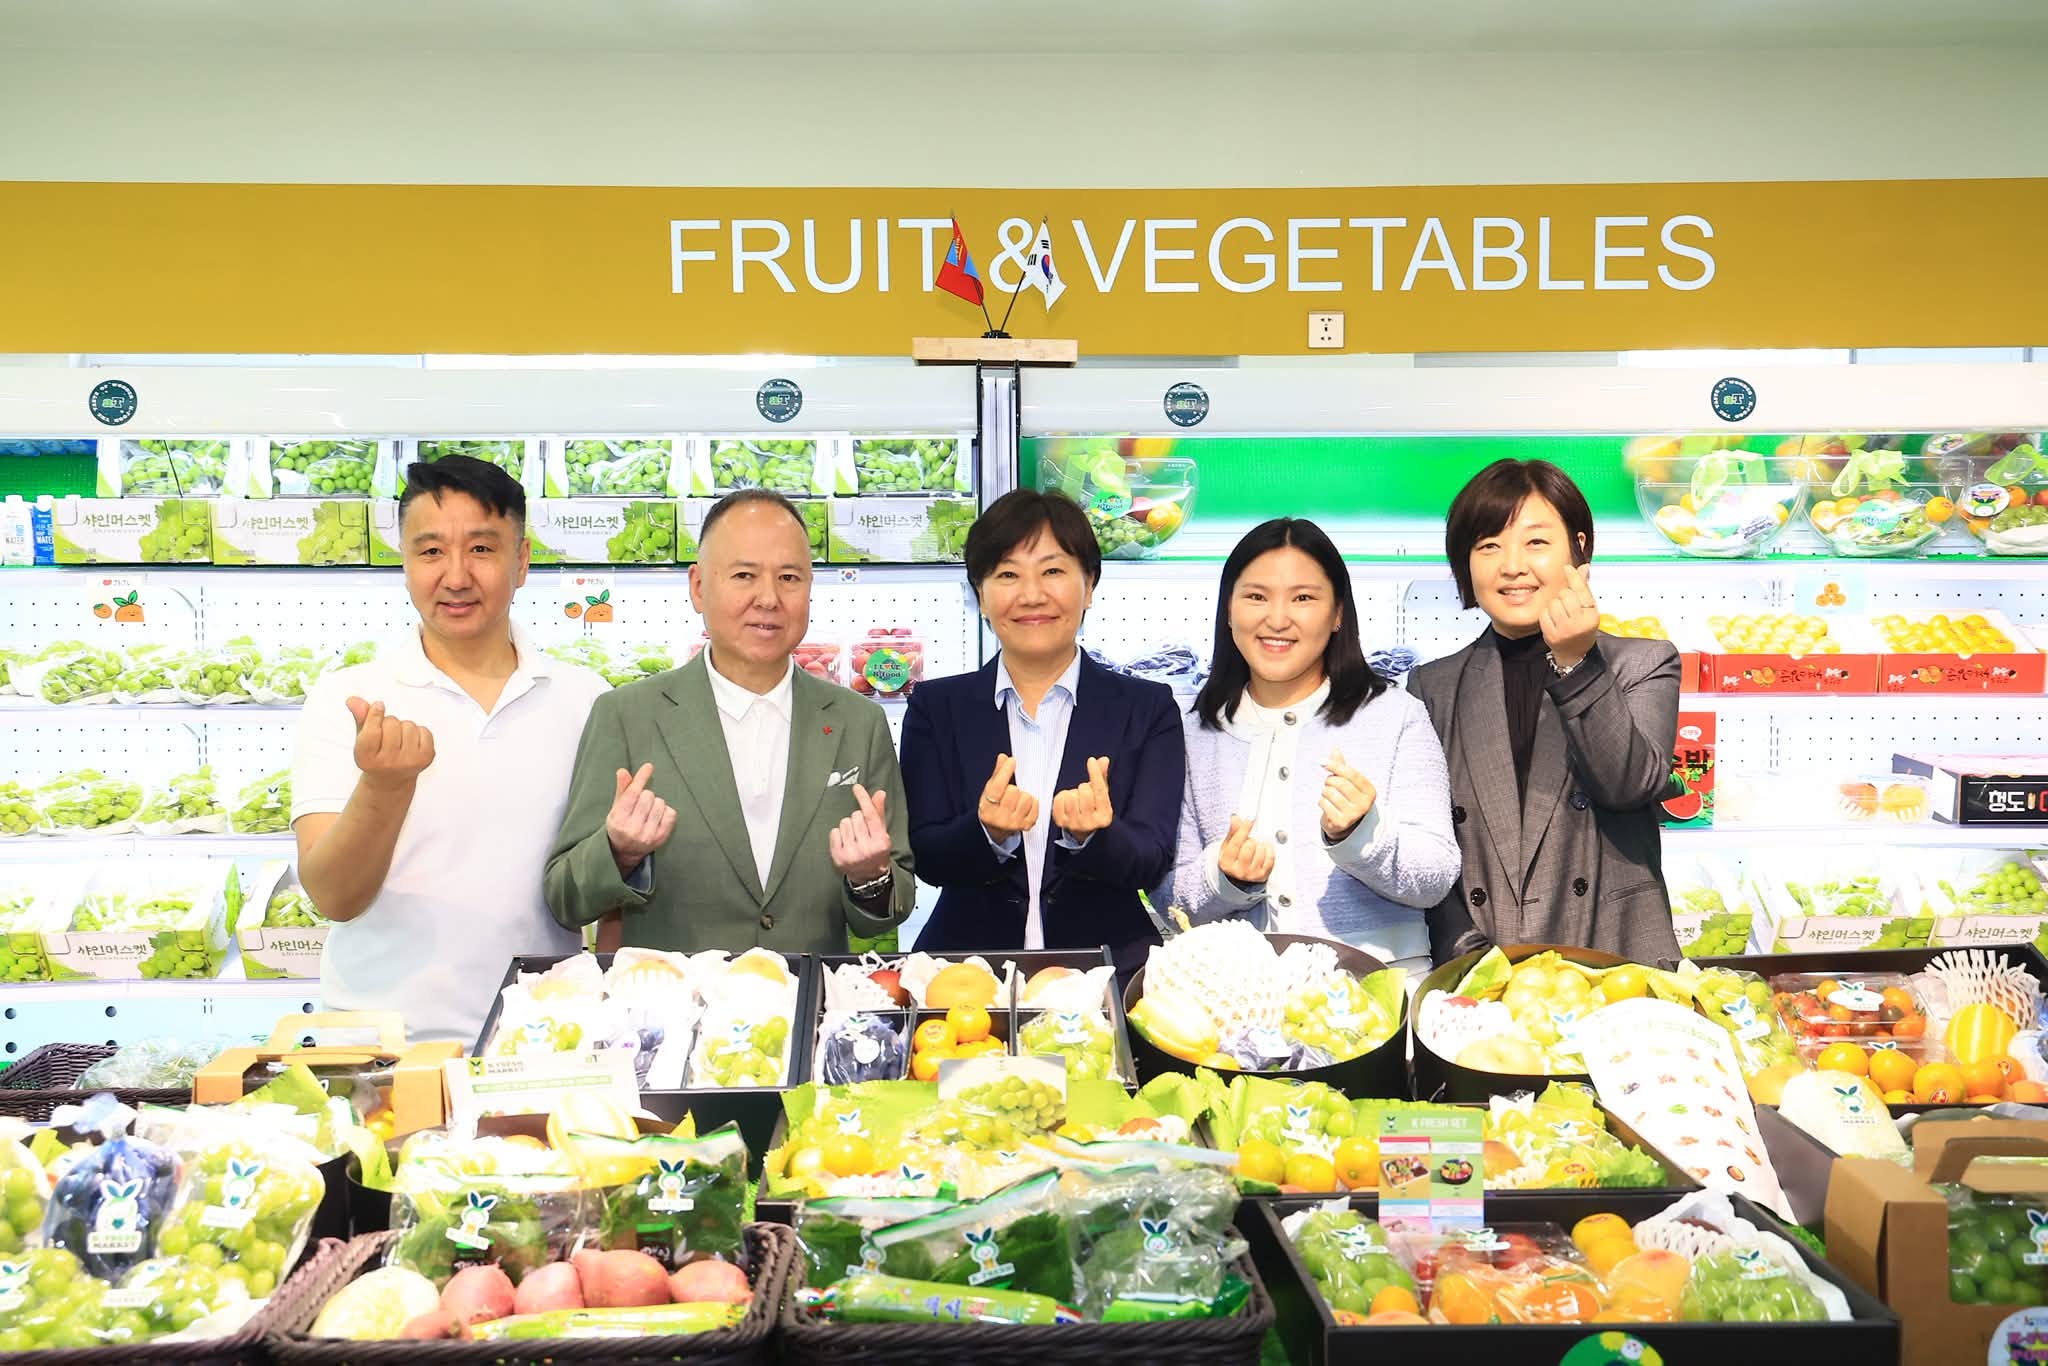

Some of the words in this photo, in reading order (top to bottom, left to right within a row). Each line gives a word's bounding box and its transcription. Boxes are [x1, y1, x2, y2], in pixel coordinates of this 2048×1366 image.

[669, 217, 956, 294] FRUIT
[1071, 214, 1716, 293] VEGETABLES
[82, 513, 151, 528] 샤인머스켓
[553, 515, 620, 529] 샤인머스켓
[857, 513, 923, 528] 샤인머스켓
[1988, 789, 2026, 812] 청도
[1808, 928, 1876, 941] 샤인머스켓
[1964, 927, 2033, 939] 샤인머스켓
[77, 944, 148, 956] 샤인머스켓
[270, 940, 324, 952] 샤인머스
